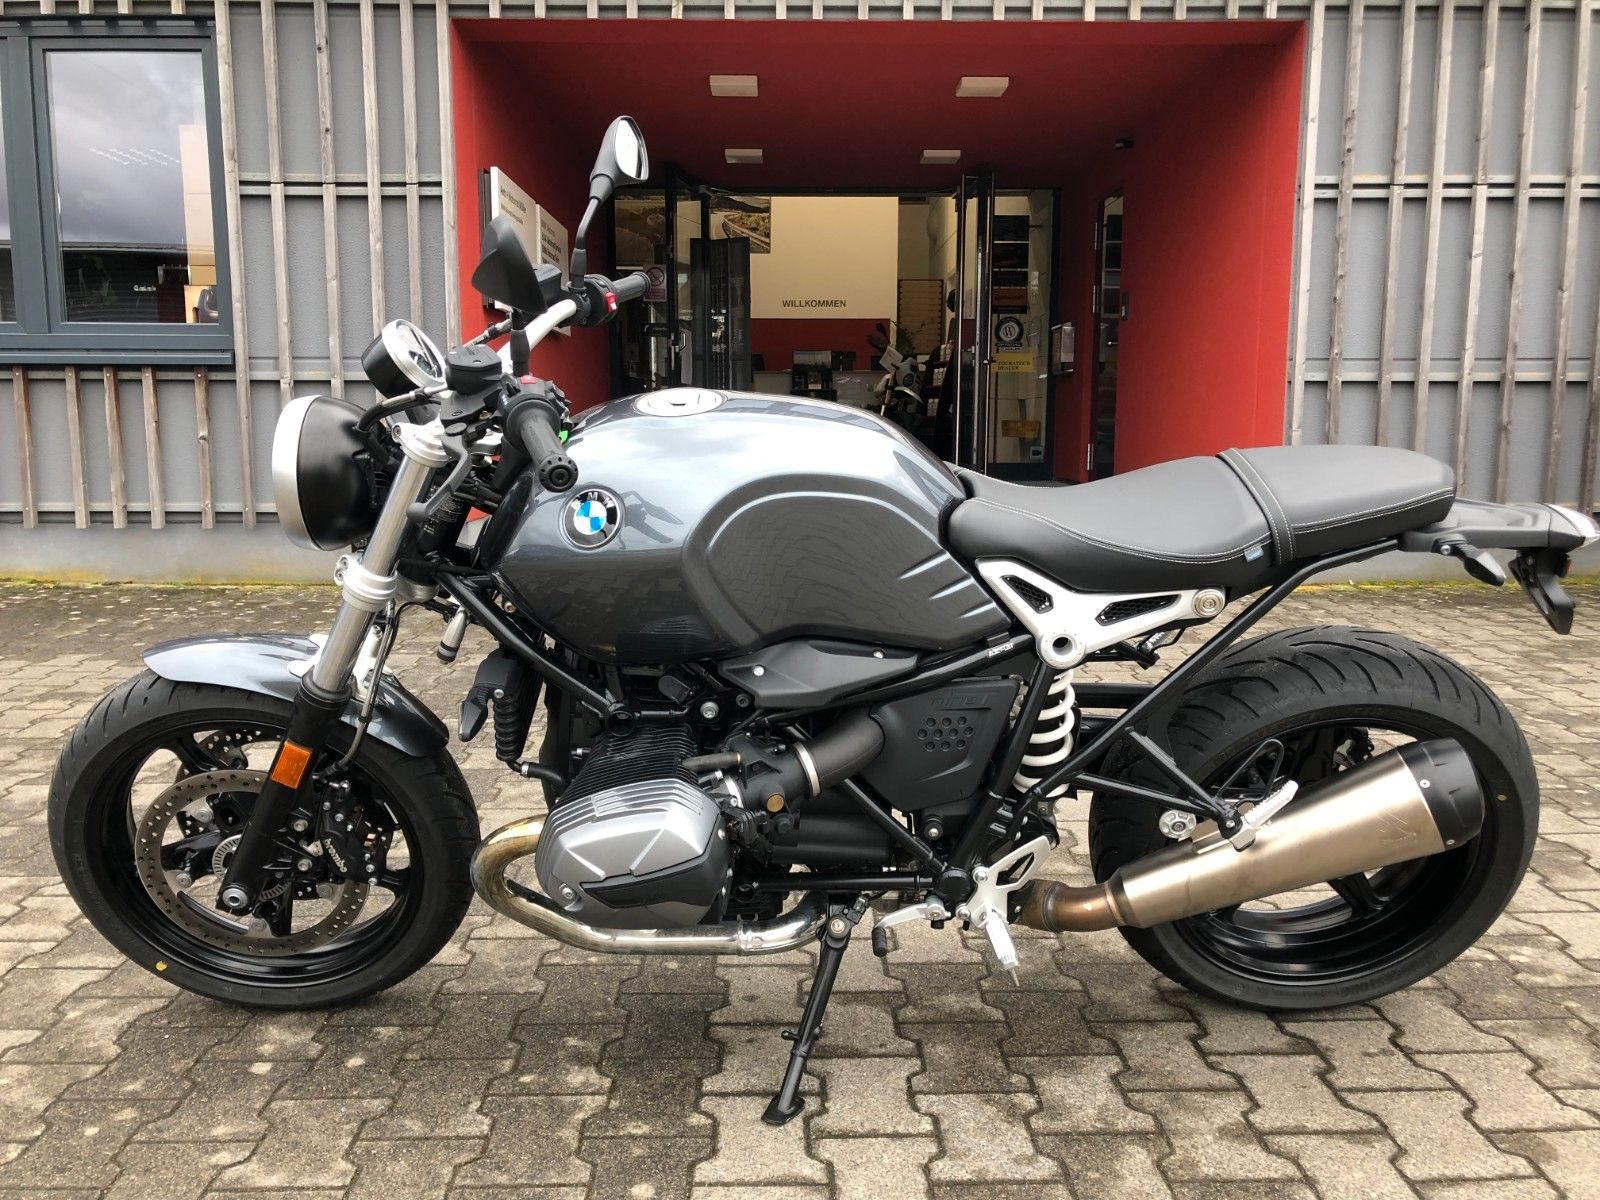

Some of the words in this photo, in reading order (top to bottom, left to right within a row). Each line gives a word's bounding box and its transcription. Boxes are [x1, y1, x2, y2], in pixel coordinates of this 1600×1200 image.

[782, 299, 847, 308] WILLKOMMEN
[570, 491, 616, 511] BMW
[324, 838, 348, 872] brembo
